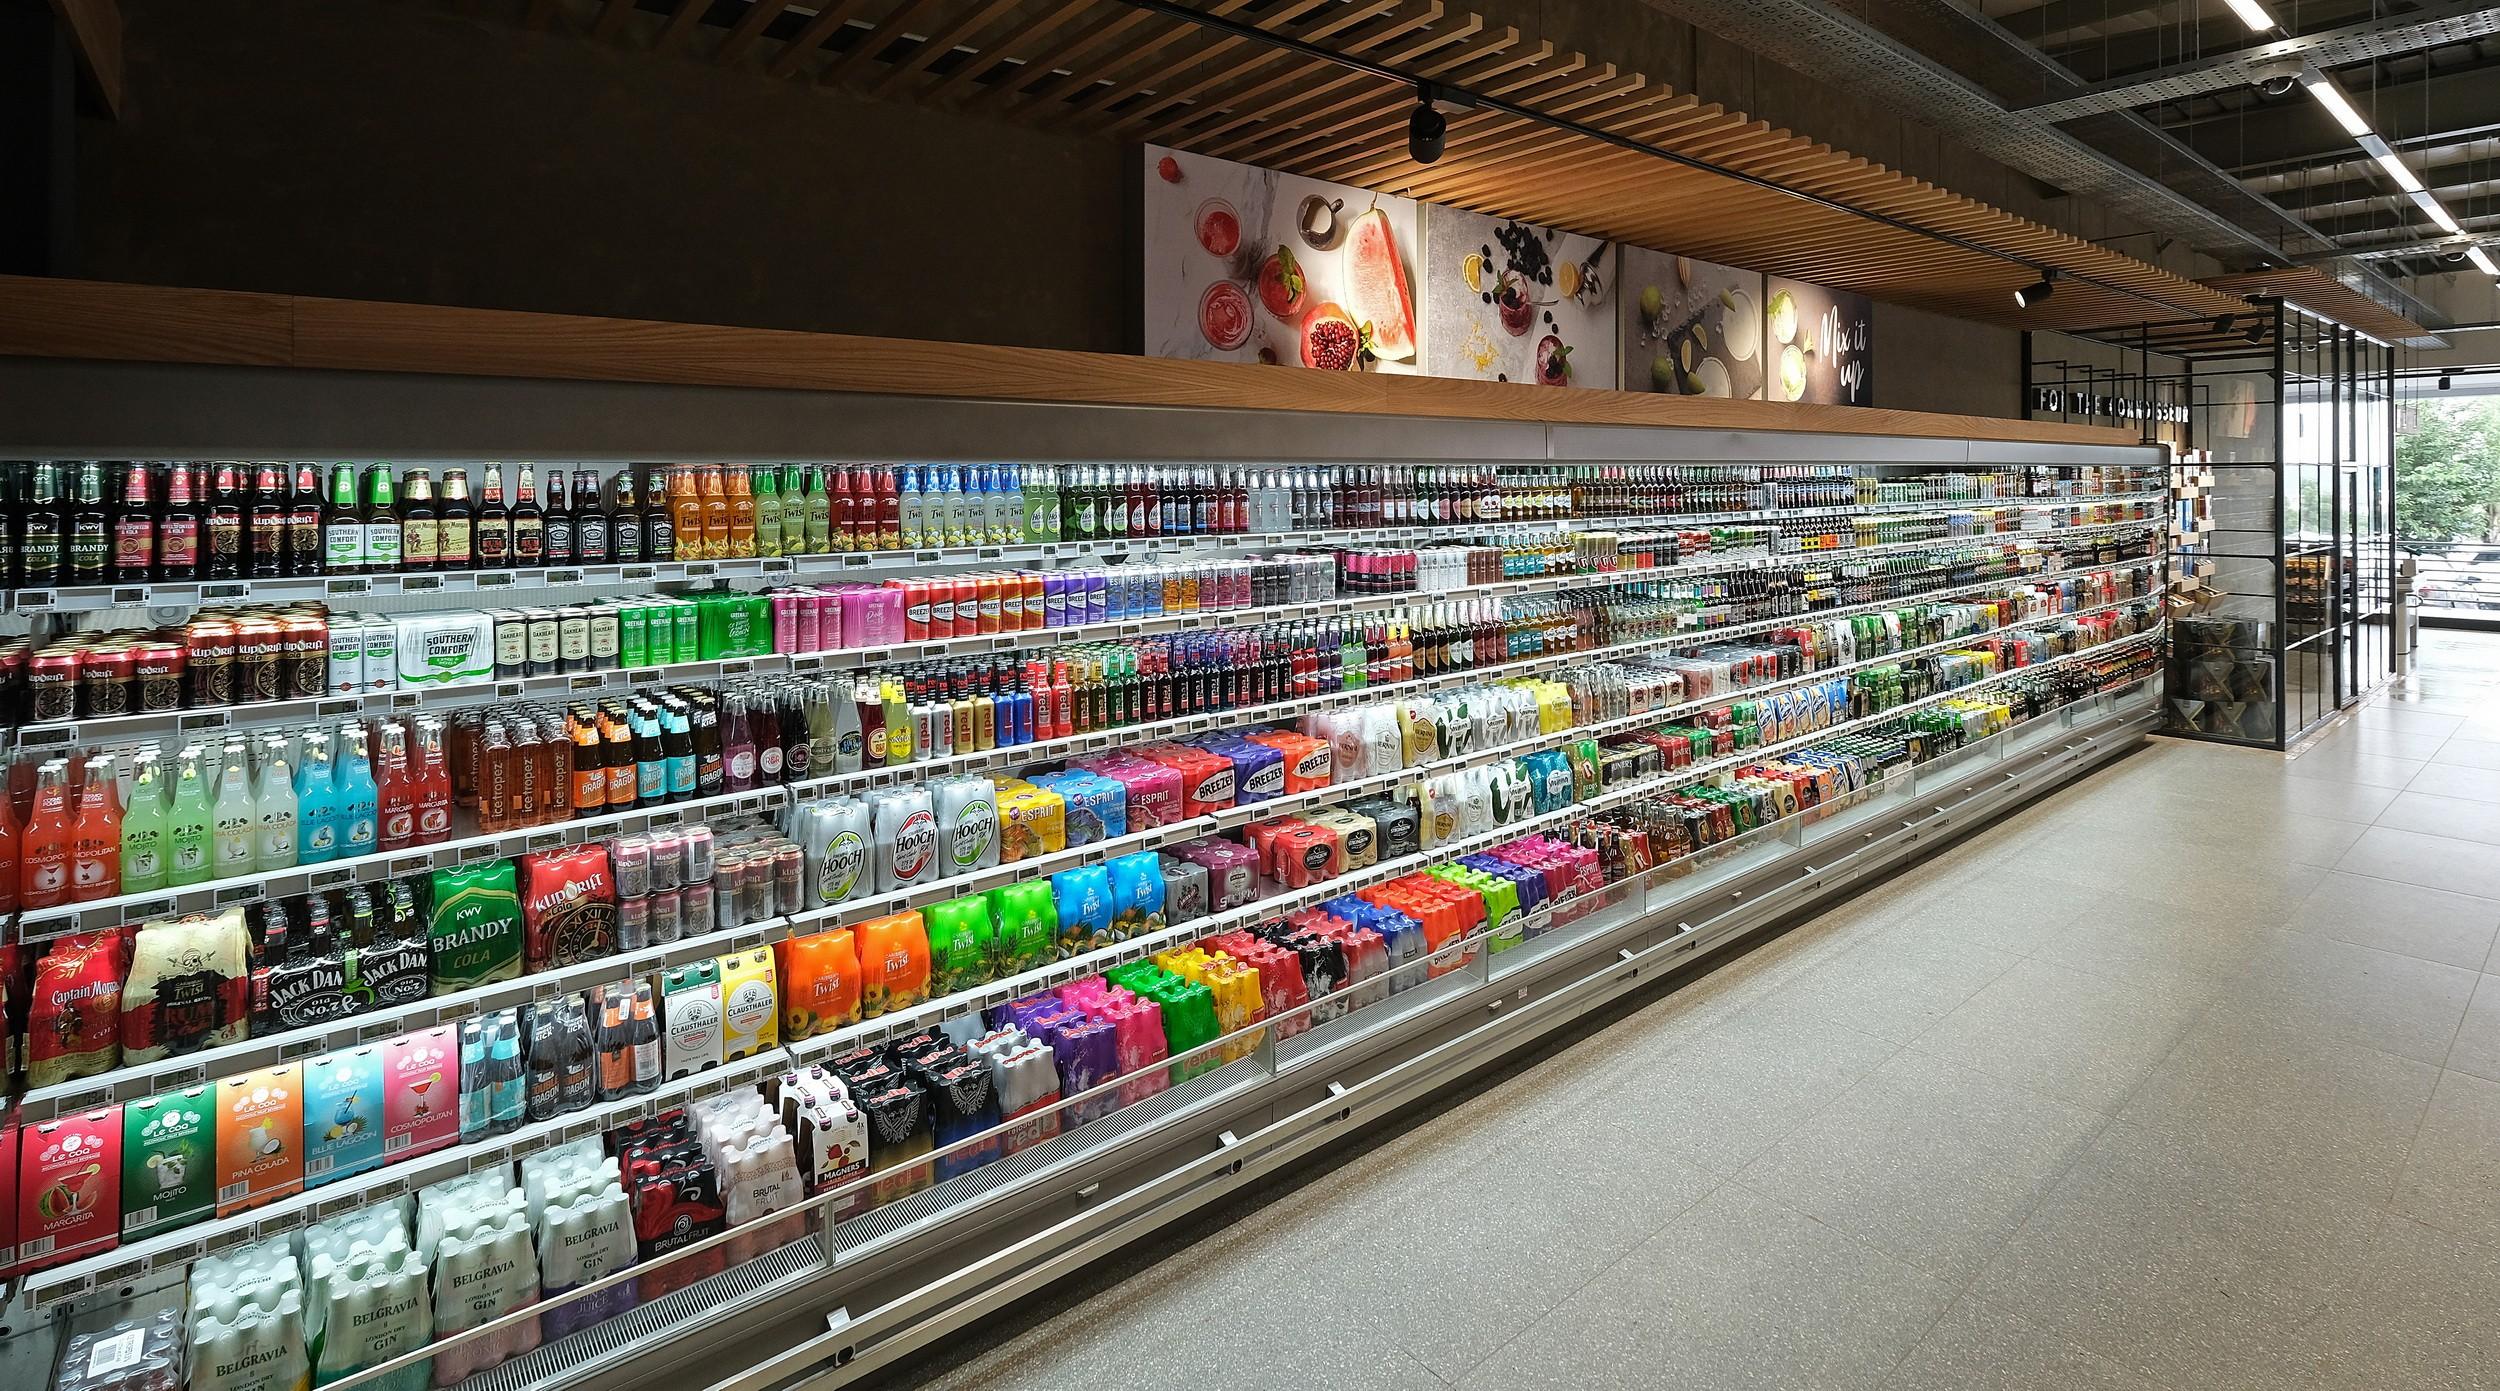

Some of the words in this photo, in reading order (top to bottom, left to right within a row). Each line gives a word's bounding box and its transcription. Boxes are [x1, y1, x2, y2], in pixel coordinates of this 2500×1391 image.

[1820, 305, 1851, 368] Mix
[1854, 320, 1867, 351] it
[1840, 360, 1865, 402] up
[681, 514, 700, 525] Twis
[708, 514, 728, 525] Twis
[761, 513, 781, 525] Twis
[810, 510, 829, 521] Twis
[328, 528, 359, 536] SOUTHERN
[329, 535, 357, 543] COMFORT
[370, 527, 399, 536] SOUTHERN
[372, 534, 398, 542] COMFORT
[70, 544, 109, 552] BRANDY
[330, 636, 360, 645] SOUTHERN
[365, 634, 394, 642] SOUTHERN
[426, 633, 474, 646] SOUTHERN
[332, 643, 359, 651] COMFORT
[428, 643, 469, 655] COMFORT
[701, 717, 717, 727] KICK
[1299, 752, 1330, 775] BREEZER
[610, 773, 636, 790] DRAGON
[1249, 765, 1284, 791] BREEZER
[1199, 775, 1235, 799] BREEZER
[1084, 791, 1115, 807] ESPRIT
[1141, 790, 1169, 806] ESPRIT
[1021, 805, 1056, 822] ESPRIT
[955, 817, 993, 841] HOOCH
[129, 841, 158, 850] MOJITO
[174, 834, 202, 844] MOJITO
[895, 829, 935, 852] HOOCH
[822, 849, 862, 874] HOOCH
[1579, 862, 1599, 876] ESPRIT
[1135, 883, 1154, 897] Twist
[456, 906, 482, 920] KWV
[1081, 900, 1101, 915] Twist
[433, 917, 513, 953] BRANDY
[1021, 920, 1043, 937] Twist
[952, 934, 975, 951] Twist
[453, 950, 491, 969] COLA
[884, 956, 910, 973] Twist
[362, 958, 398, 987] JACK
[399, 952, 428, 969] DAN
[270, 979, 310, 1009] JACK
[312, 970, 344, 989] DAN
[813, 977, 840, 997] Twist
[52, 989, 90, 1005] Captain
[342, 995, 362, 1013] &
[303, 1000, 339, 1018] No.7
[727, 998, 773, 1017] CLAUSTHALER
[671, 1016, 719, 1036] CLAUSTHALER
[534, 1029, 553, 1042] KICK
[531, 1086, 560, 1106] DRAGON
[390, 1110, 453, 1134] COSMOPOLITAN
[312, 1143, 334, 1156] BLUE
[335, 1130, 377, 1149] LAGOON
[254, 1156, 290, 1173] COLADA
[823, 1163, 861, 1181] MAGNERS
[153, 1186, 187, 1201] MOJITO
[752, 1183, 781, 1199] BRUTAL
[43, 1211, 95, 1232] MARGARITA
[564, 1221, 620, 1248] BELGRAVIA
[576, 1250, 598, 1261] LONDON
[598, 1246, 609, 1256] DRY
[583, 1256, 604, 1269] GIN
[453, 1260, 515, 1289] BELGRAVIA
[465, 1291, 490, 1304] LONDON
[491, 1286, 503, 1295] DRY
[352, 1297, 419, 1328] BELGRAVIA
[473, 1298, 497, 1312] GIN
[365, 1330, 390, 1344] LONDON
[391, 1325, 406, 1334] DRY
[373, 1335, 398, 1350] GIN
[215, 1345, 288, 1378] BELGRAVIA
[256, 1374, 273, 1384] DRY
